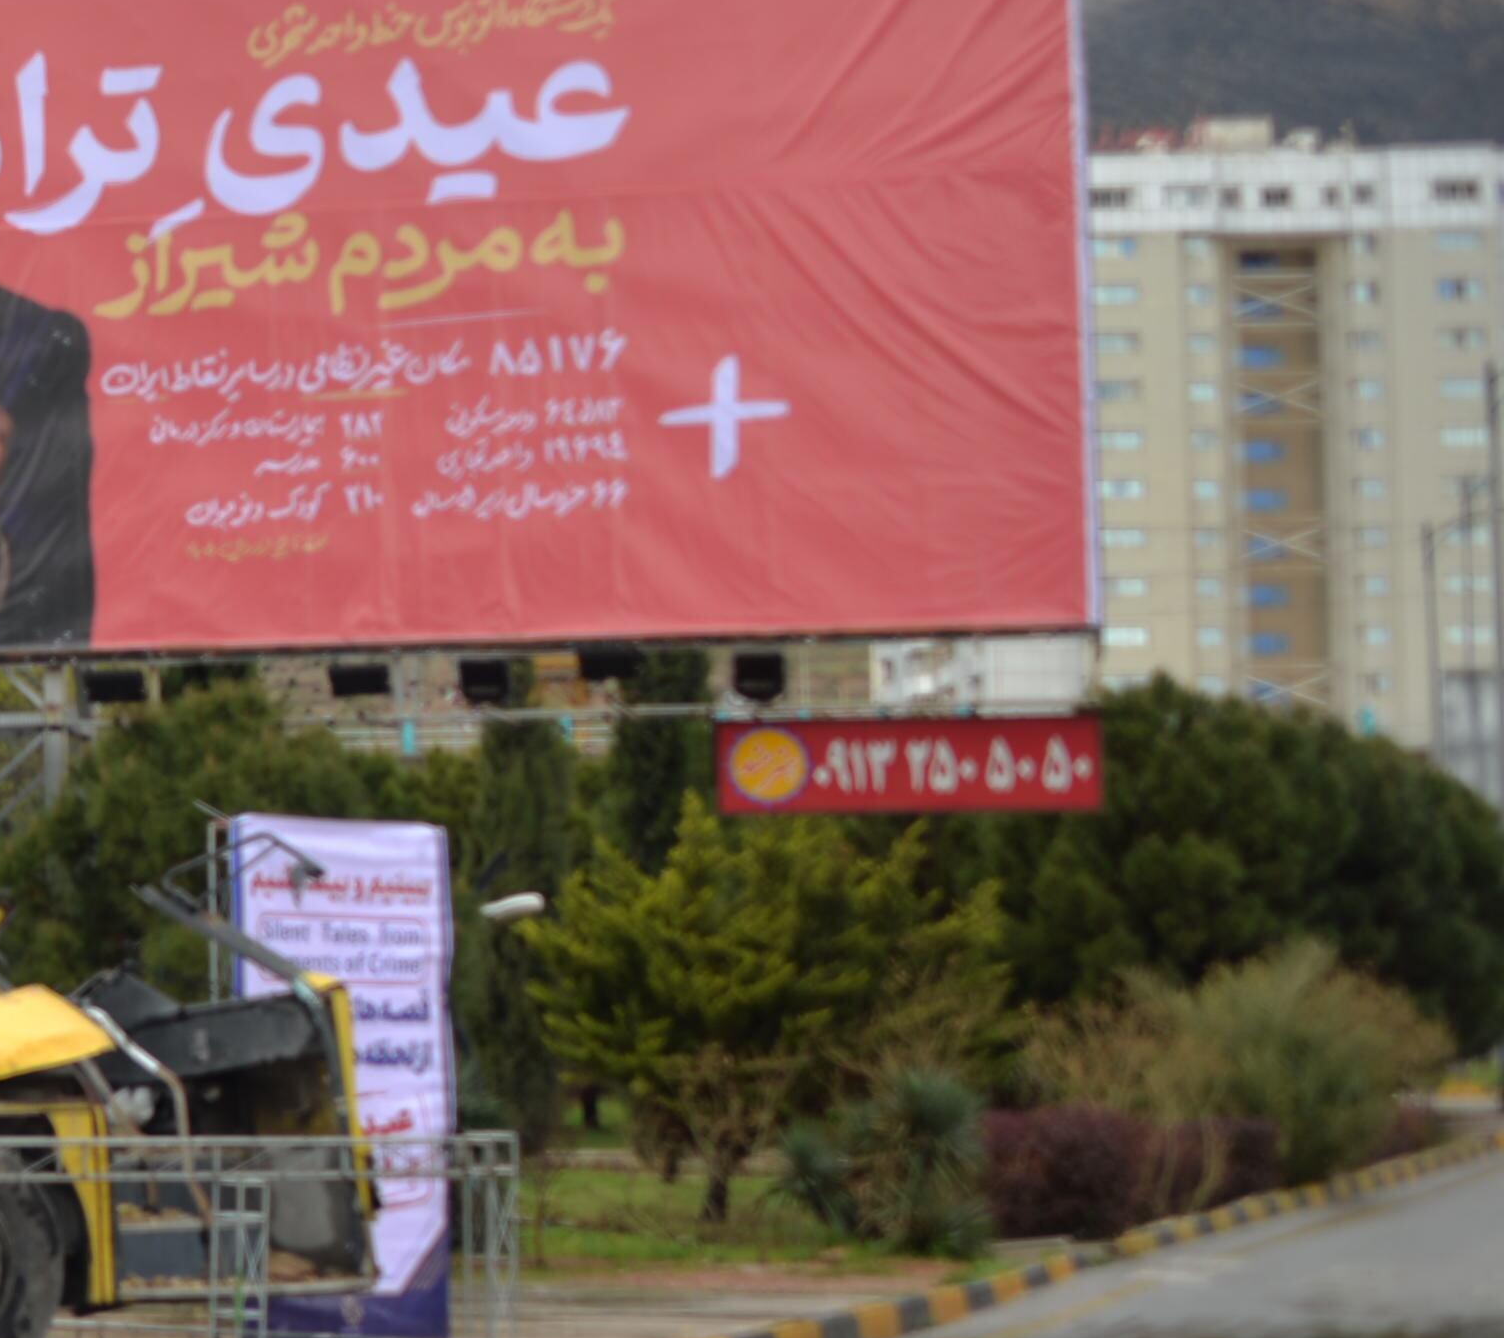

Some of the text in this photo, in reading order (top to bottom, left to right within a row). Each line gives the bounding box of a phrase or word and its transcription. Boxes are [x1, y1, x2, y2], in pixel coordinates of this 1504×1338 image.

[94, 208, 625, 318] به مردم شیراز
[489, 328, 628, 377] ۸۵۱۷۶
